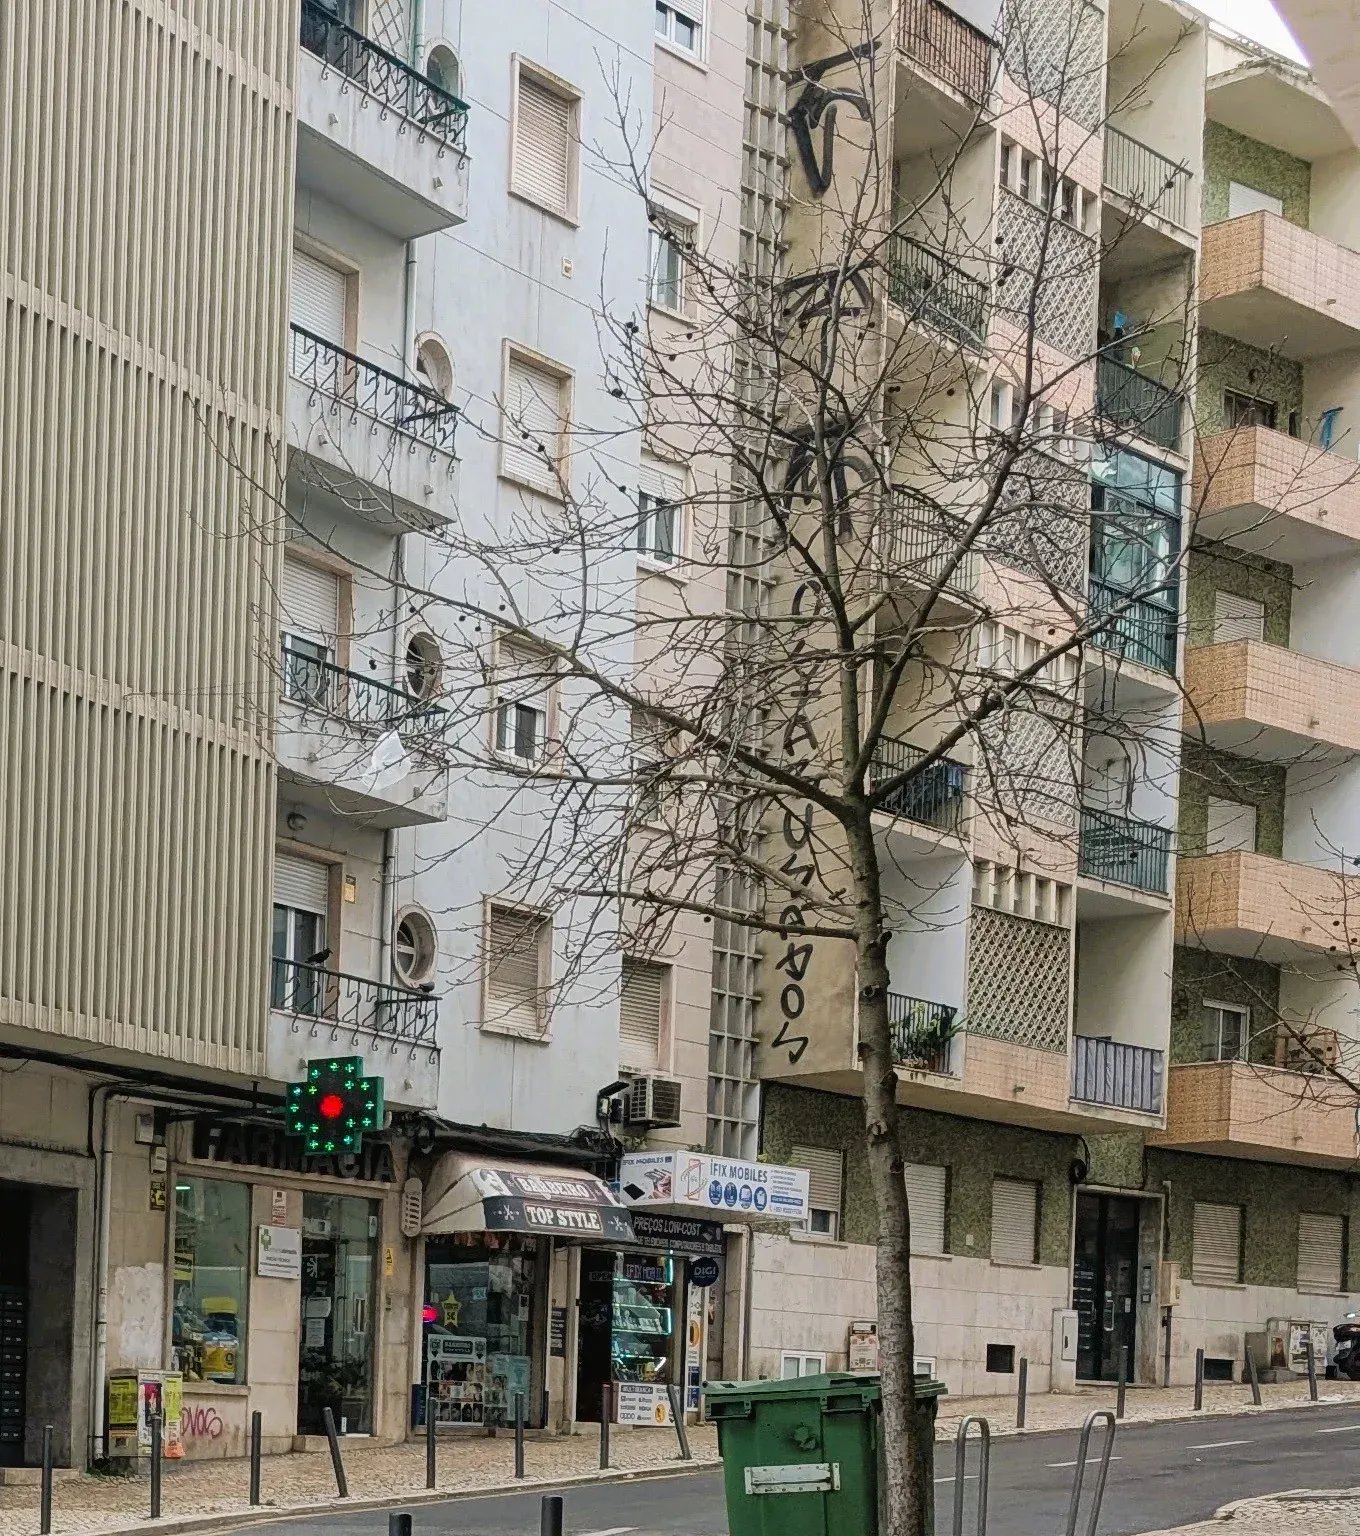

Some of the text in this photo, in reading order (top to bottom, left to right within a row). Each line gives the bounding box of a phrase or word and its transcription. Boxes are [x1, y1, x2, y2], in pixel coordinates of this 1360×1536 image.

[729, 1165, 768, 1183] MOBILES
[526, 1205, 600, 1230] TOP STYLE
[633, 1216, 663, 1234] PREÇOS
[694, 1266, 716, 1276] DIGI
